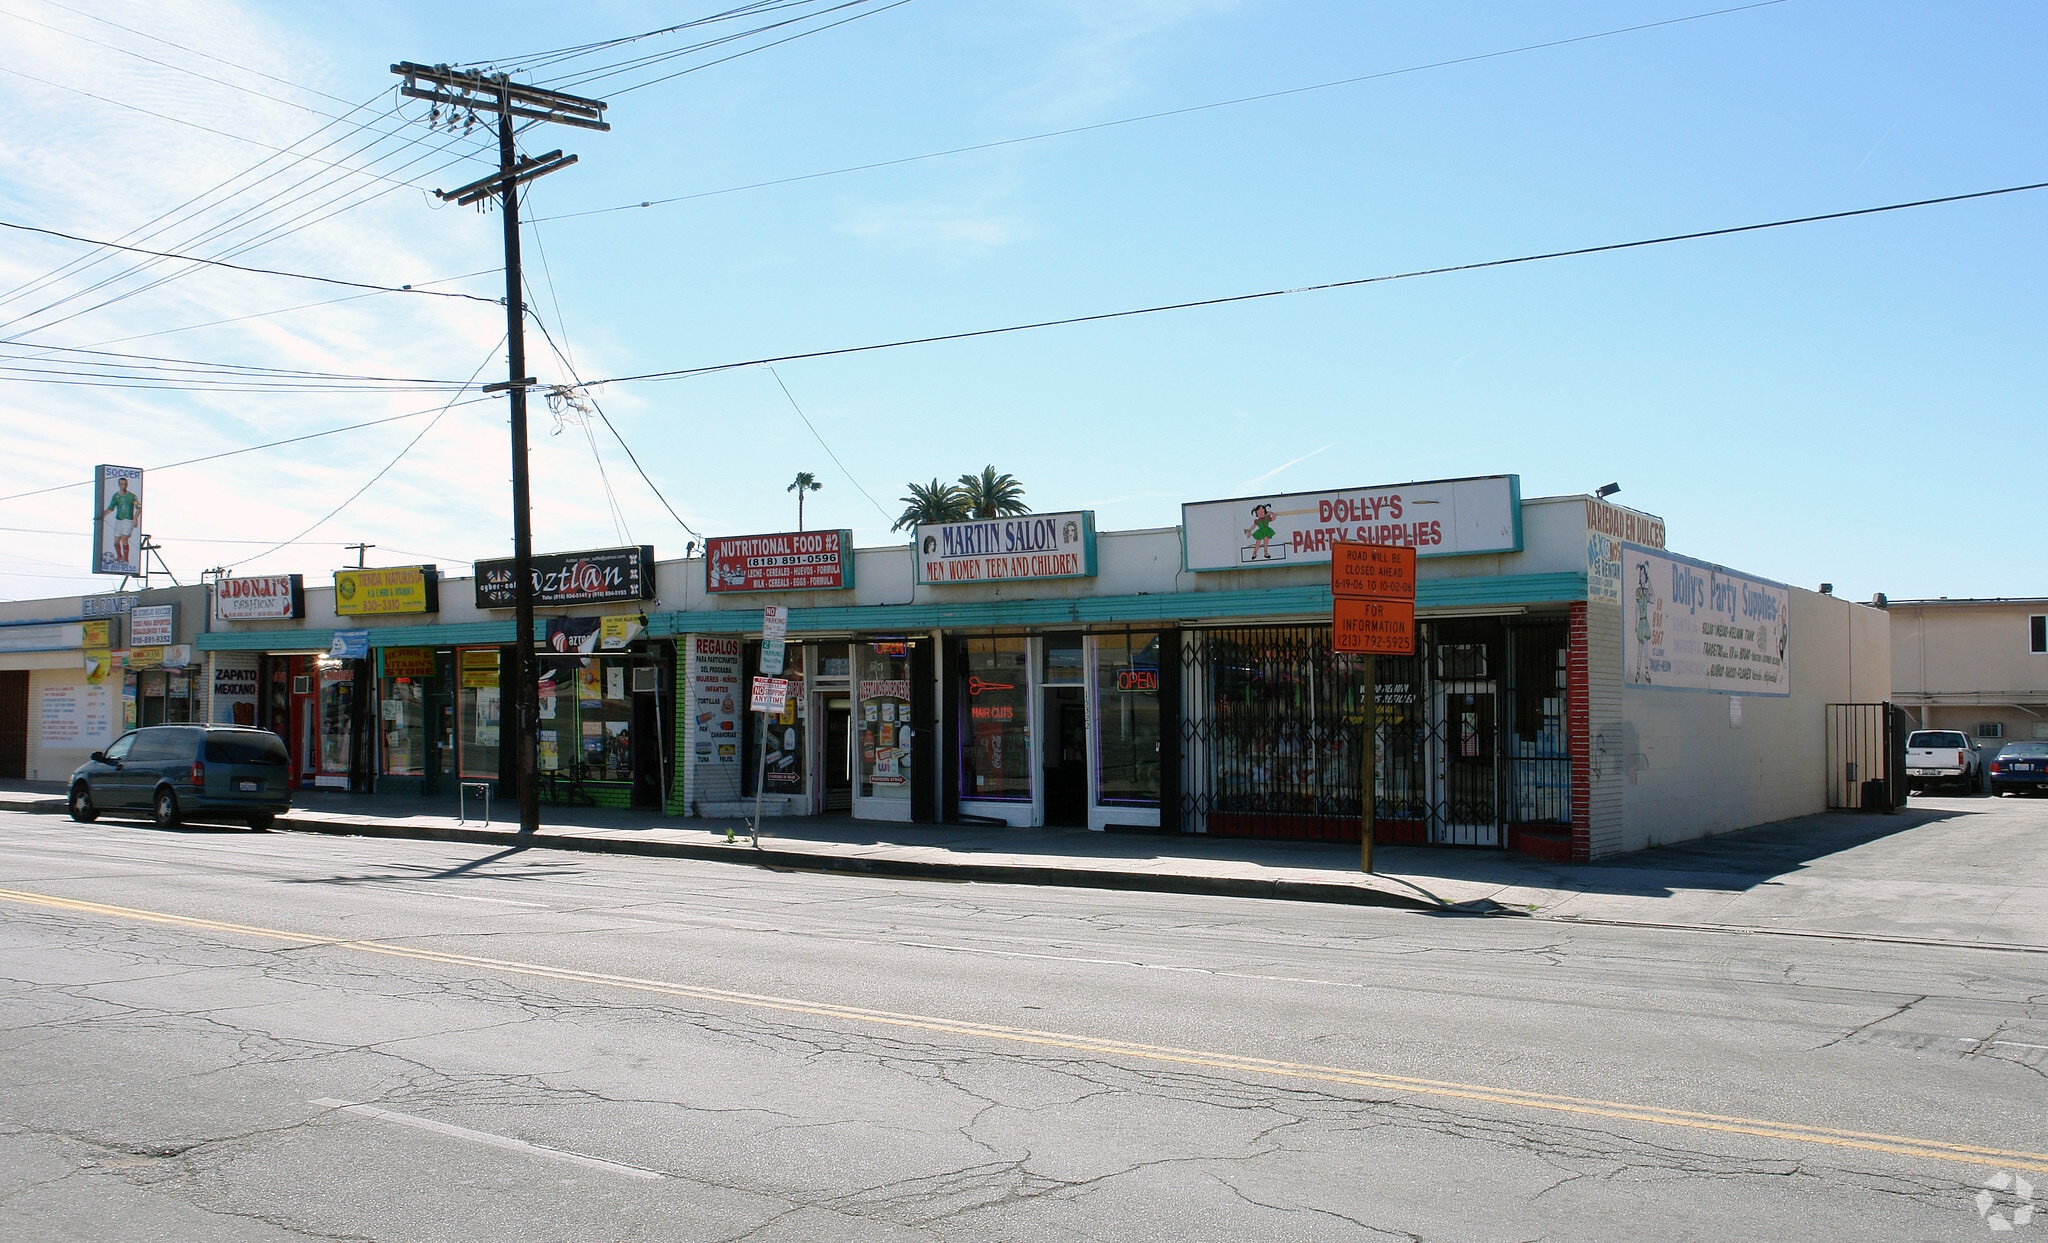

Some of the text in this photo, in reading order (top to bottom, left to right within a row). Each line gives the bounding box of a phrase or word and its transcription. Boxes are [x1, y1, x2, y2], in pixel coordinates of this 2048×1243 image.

[106, 467, 140, 479] SOCCER
[1319, 495, 1403, 523] DOLLY'S
[1586, 500, 1664, 549] VARIEDAD EN DULCES
[943, 519, 1057, 556] MARTIN SALON
[1292, 520, 1442, 553] PARTY SUPPLIES
[721, 534, 839, 558] NUTRITIONAL FOOD #2
[748, 554, 837, 567] (818) 891-0596
[1347, 550, 1402, 563] ROAD WILL BE
[748, 565, 840, 578] LECHE CEREALES HUEVOS FORMULA
[926, 553, 1079, 581] MEN WOMEN TEEN AND CHILDREN
[1345, 565, 1403, 578] CLOSED AHEAD
[358, 569, 422, 587] TIENDA NATURISTA
[768, 578, 789, 588] CEREALS
[810, 576, 834, 586] FORMULA
[1335, 579, 1412, 592] 6-19-06 TO 10-02-06
[1671, 563, 1777, 622] Dolly's Party Supplies
[84, 596, 139, 617] EL CONEJO
[234, 599, 275, 611] FASHION
[766, 607, 775, 616] NO
[1365, 604, 1384, 616] FOR
[766, 617, 785, 625] PARKING
[1342, 619, 1405, 633] INFORMATION
[696, 639, 738, 655] REGALOS
[764, 640, 769, 649] 2
[1338, 634, 1410, 649] (213) 792-5925
[216, 669, 257, 681] ZAPATO
[385, 668, 434, 676] STORE
[1119, 671, 1156, 690] OPEN
[215, 683, 256, 695] MEXICANO
[754, 687, 764, 695] NO
[972, 707, 1013, 719] HAIR CUTS
[878, 760, 898, 773] wic
